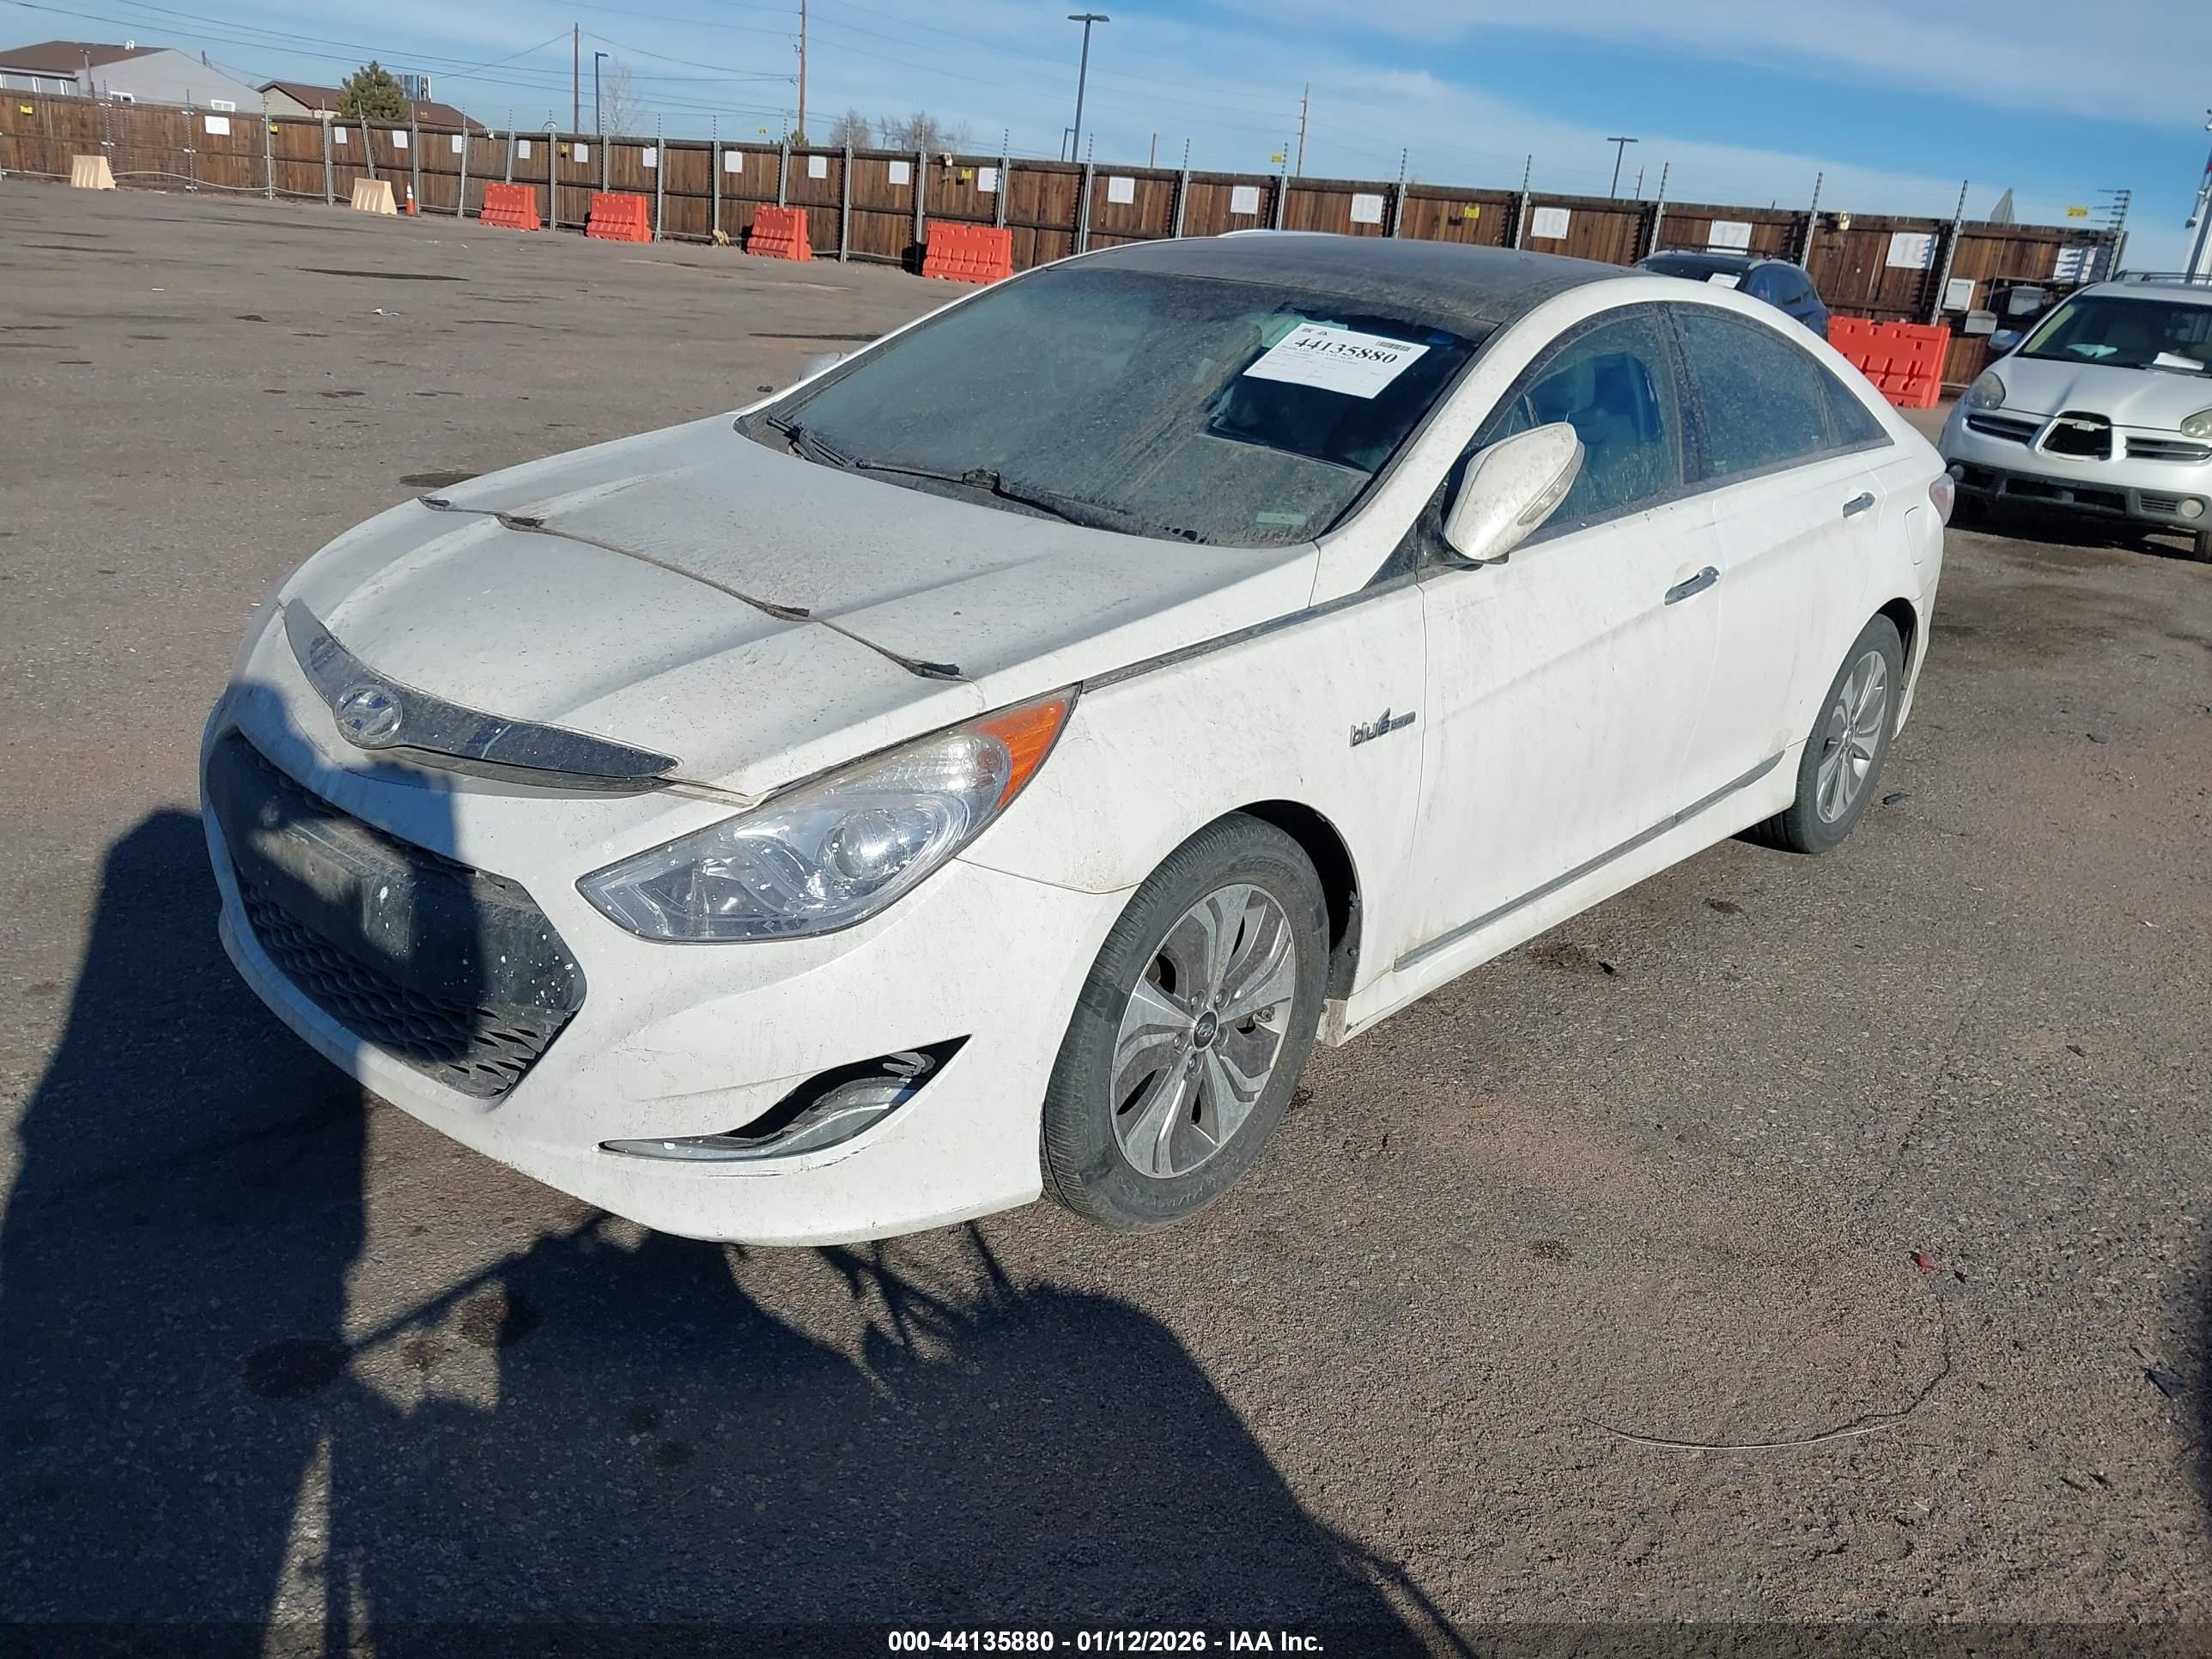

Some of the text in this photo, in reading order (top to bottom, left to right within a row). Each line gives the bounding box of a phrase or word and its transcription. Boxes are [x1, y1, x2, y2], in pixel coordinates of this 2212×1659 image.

[1541, 211, 1562, 234] 16
[1717, 224, 1744, 244] 17
[1294, 337, 1398, 364] 44135880
[1350, 708, 1390, 747] blue
